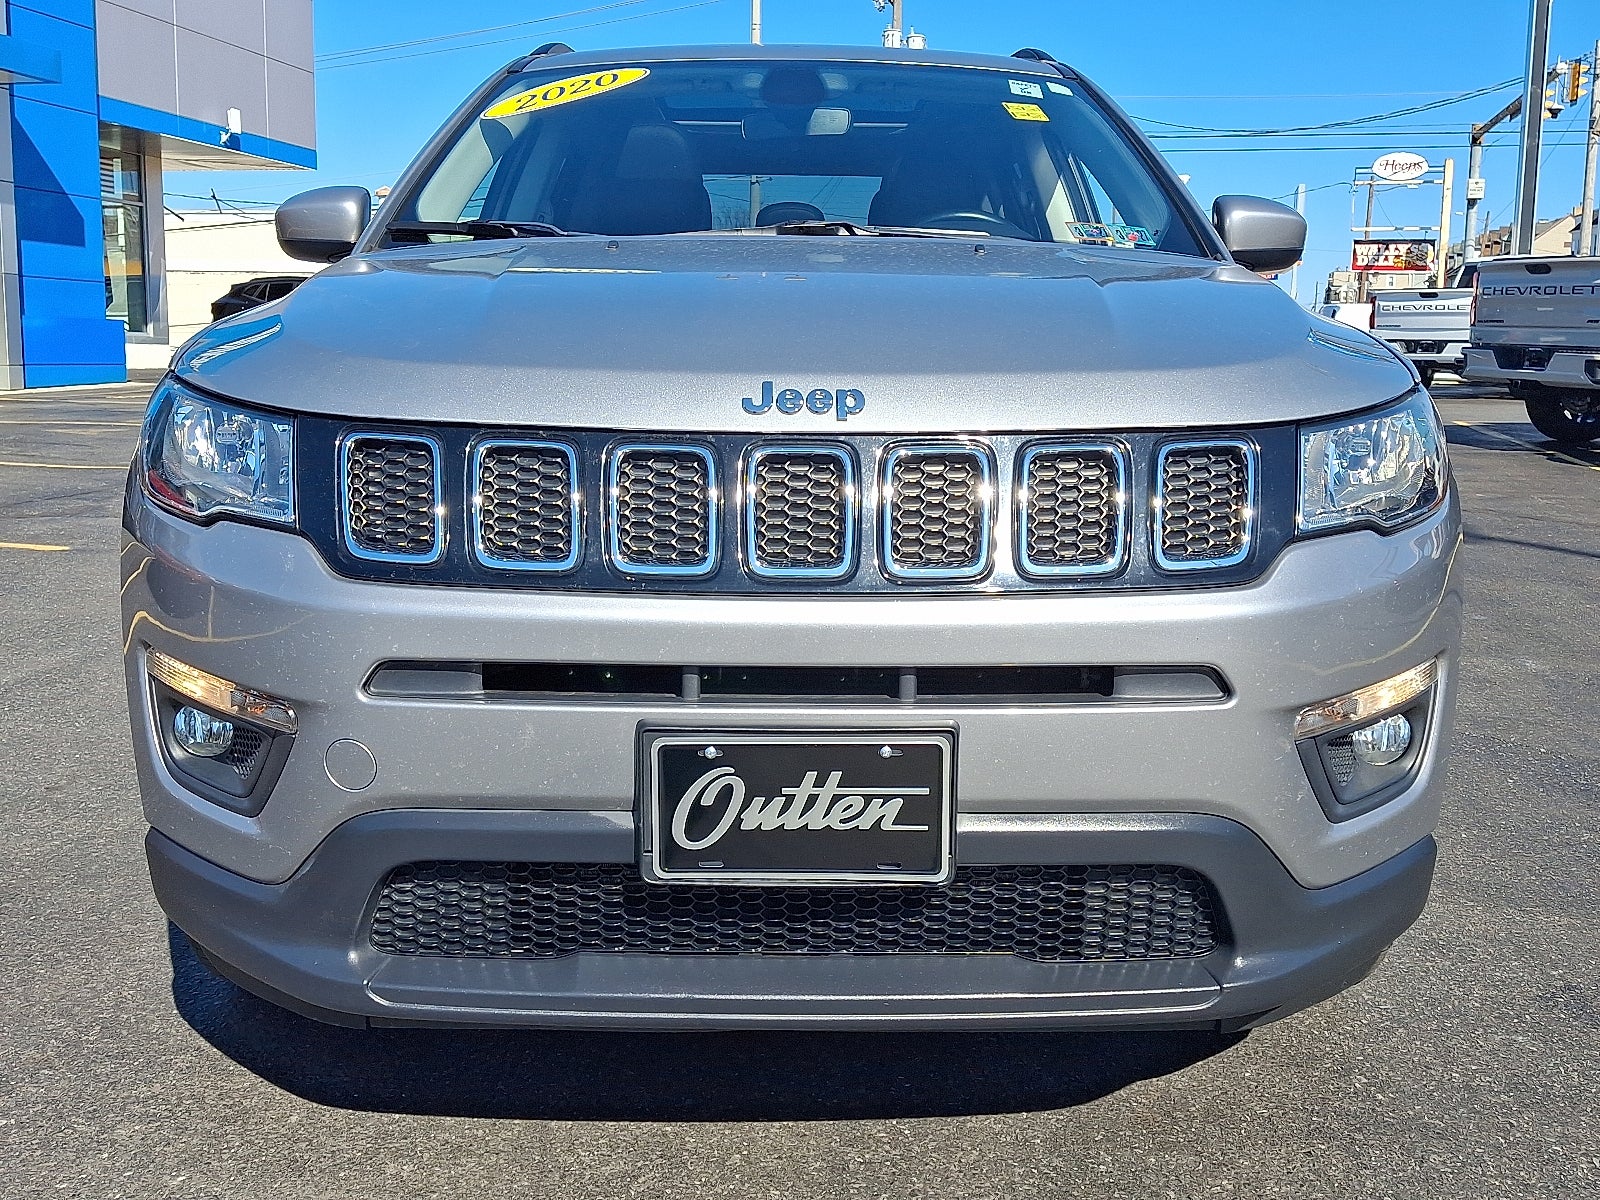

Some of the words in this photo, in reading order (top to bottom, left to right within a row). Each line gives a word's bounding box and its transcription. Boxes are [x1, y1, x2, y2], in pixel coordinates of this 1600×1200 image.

[514, 73, 619, 112] 2020
[1482, 284, 1600, 296] CHEVROLET
[741, 380, 866, 422] Jeep
[671, 766, 930, 851] Outten
